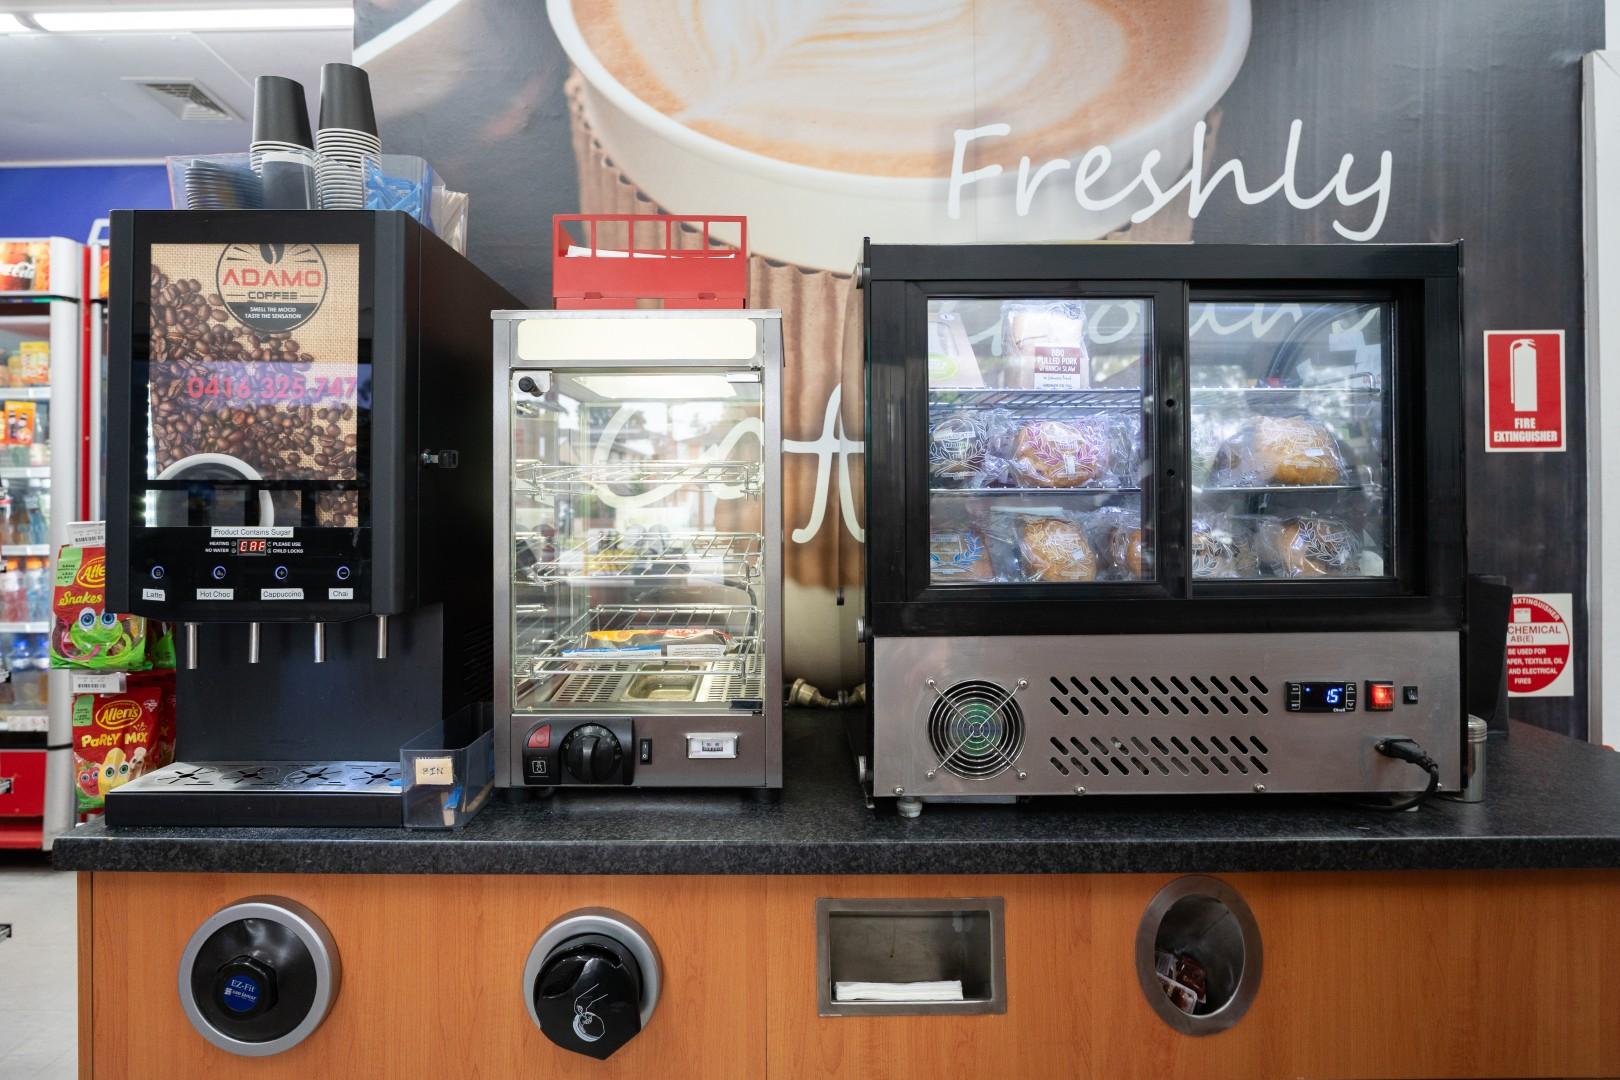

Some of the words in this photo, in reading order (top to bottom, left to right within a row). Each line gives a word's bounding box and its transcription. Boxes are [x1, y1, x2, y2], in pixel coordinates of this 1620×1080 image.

[947, 119, 1393, 242] Freshly
[223, 268, 322, 288] ADAMO
[248, 291, 298, 300] COFFEE
[187, 376, 250, 400] 0416
[261, 376, 305, 399] 325
[314, 376, 357, 399] 747
[1514, 417, 1537, 429] FIRE
[1493, 430, 1558, 443] EXTINGUISHER
[213, 528, 239, 536] Product
[240, 528, 270, 536] Contains
[270, 528, 292, 537] Sugar
[58, 590, 103, 606] Snakes
[146, 591, 163, 599] Latte
[263, 590, 302, 598] Cappuccino
[1512, 597, 1560, 622] EXTINGUISHER
[1507, 625, 1562, 635] CHEMICAL
[1514, 677, 1532, 685] FIRES
[101, 706, 139, 723] Allen's
[422, 767, 444, 776] BIN
[231, 979, 255, 992] EZ-Fit
